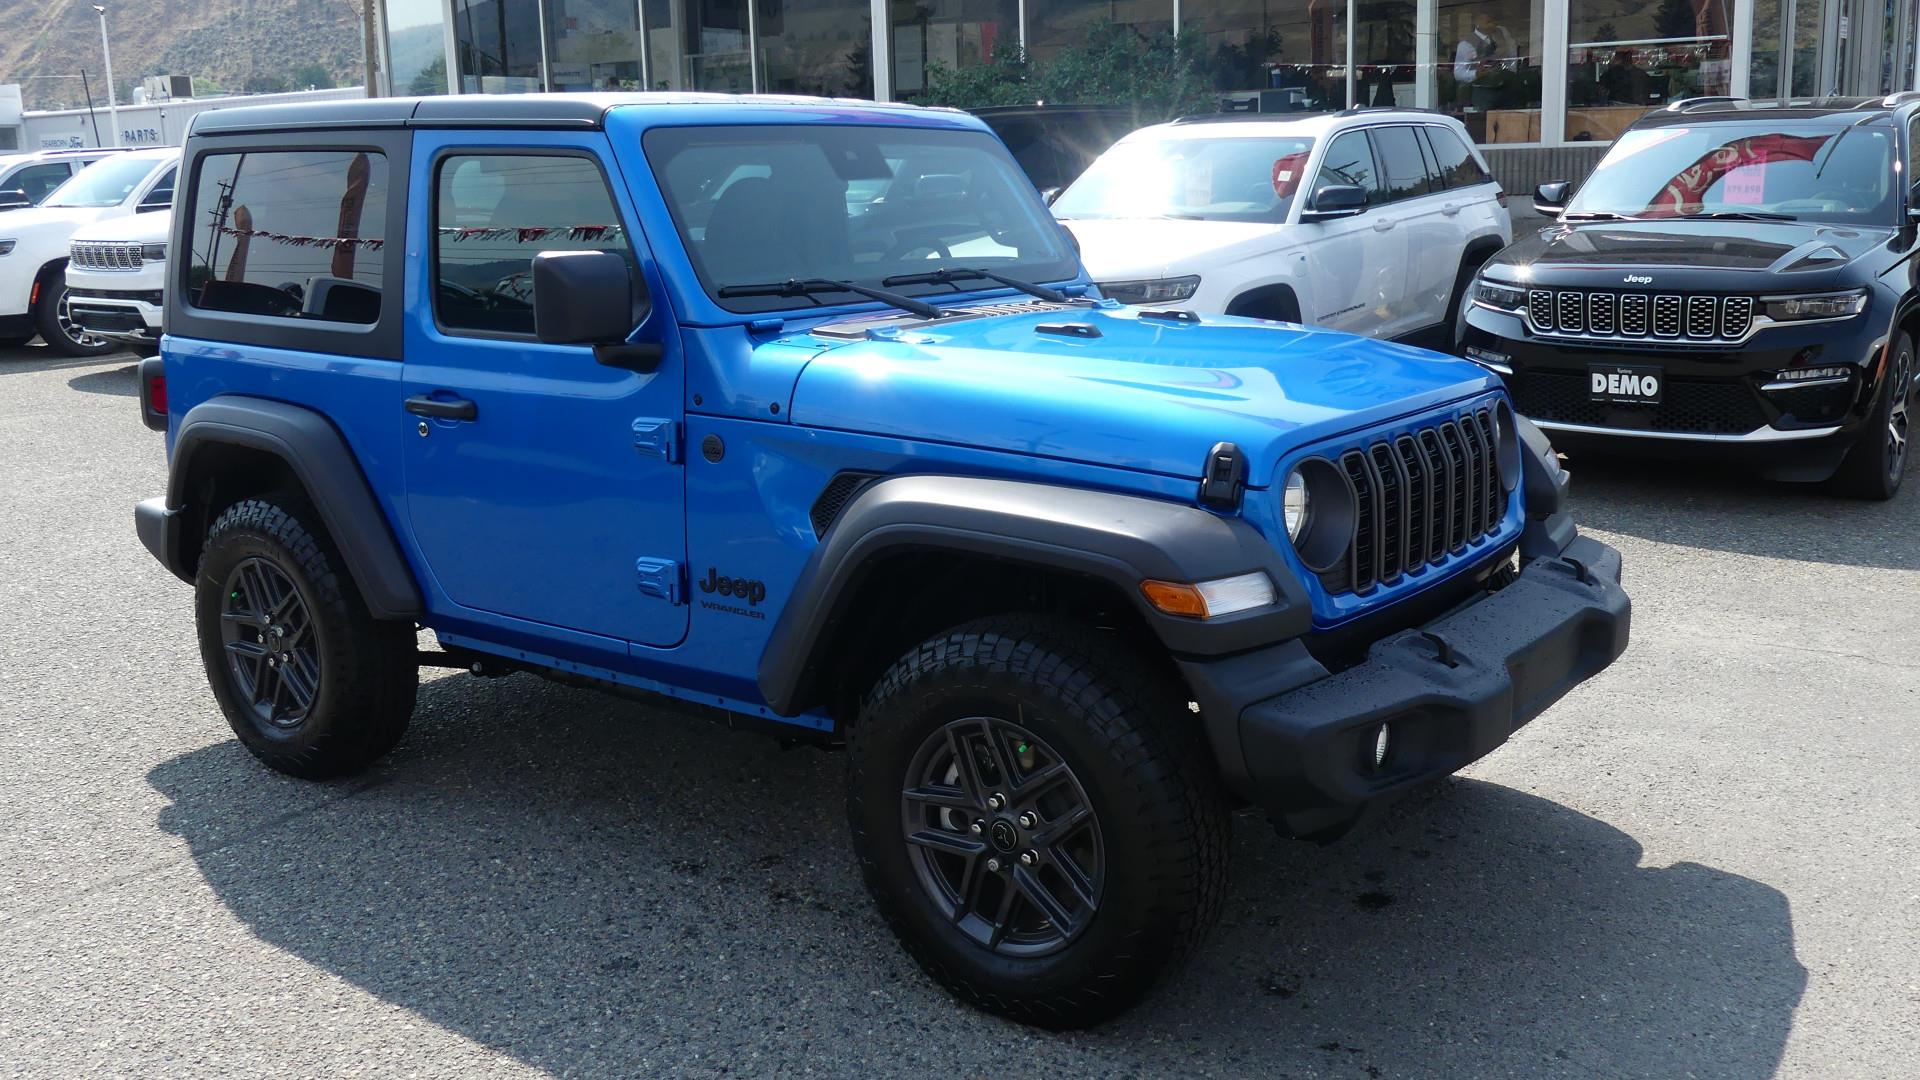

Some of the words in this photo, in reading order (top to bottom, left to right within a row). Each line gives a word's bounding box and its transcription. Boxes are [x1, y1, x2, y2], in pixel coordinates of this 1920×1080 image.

[124, 128, 155, 143] PARTS
[1623, 274, 1653, 284] Jeep
[1591, 372, 1658, 397] DEMO
[699, 567, 766, 607] Jeep
[701, 600, 766, 620] WRANGLER
